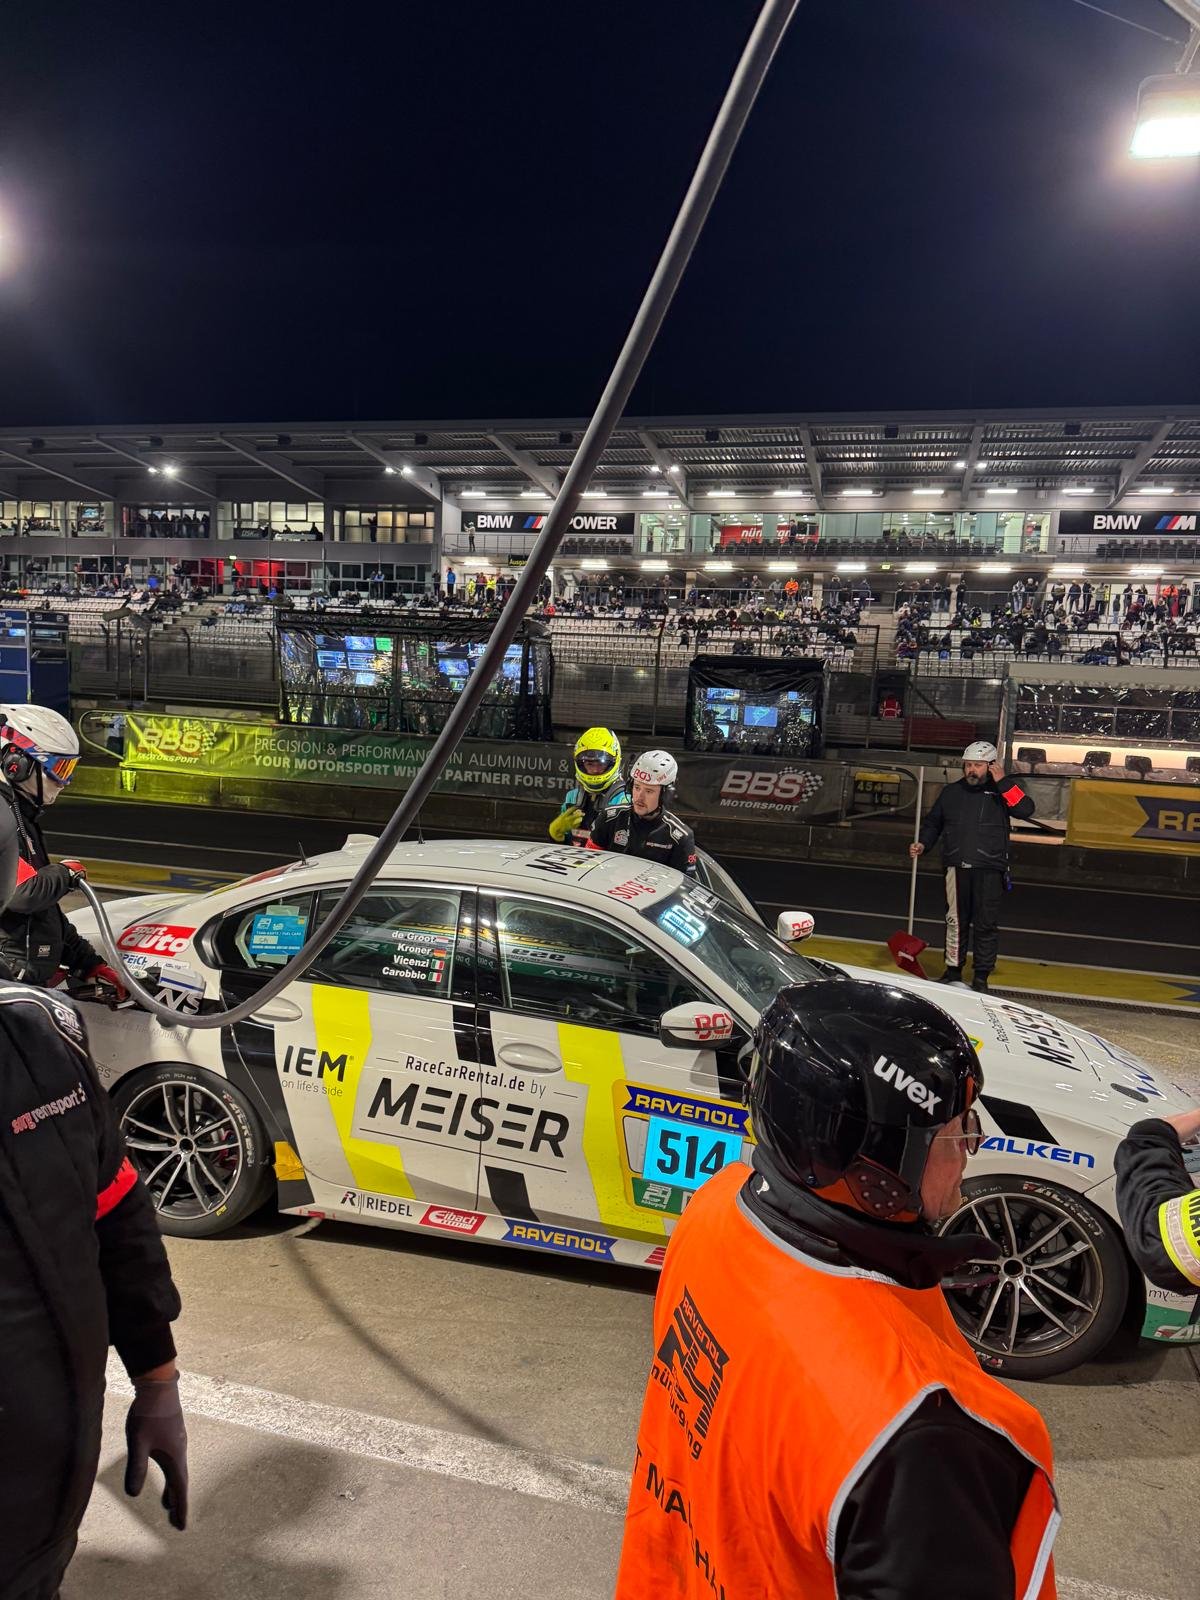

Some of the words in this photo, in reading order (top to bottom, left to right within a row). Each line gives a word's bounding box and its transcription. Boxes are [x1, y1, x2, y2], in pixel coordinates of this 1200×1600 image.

[477, 515, 514, 529] BMW
[1093, 515, 1141, 530] BMW
[137, 727, 202, 757] BBS
[255, 736, 322, 754] PRECISION
[326, 743, 337, 756] &
[342, 743, 432, 762] PERFORMAN
[468, 753, 552, 772] ALUMINUM
[558, 759, 569, 772] &
[137, 752, 199, 764] MOTORSPORT
[253, 755, 291, 769] YOUR
[294, 761, 390, 777] MOTORSPORT
[445, 769, 511, 785] PARTNER
[514, 774, 543, 788] FOR
[720, 770, 804, 802] BBS
[719, 799, 799, 813] MOTORSPORT
[121, 934, 191, 953] auto
[132, 926, 168, 936] sport
[391, 930, 404, 939] de
[407, 932, 436, 943] Groot
[393, 954, 429, 967] Vicenzi
[397, 943, 431, 955] Kroner
[382, 966, 427, 980] Carobbio
[283, 1045, 348, 1083] IEM
[282, 1079, 294, 1089] on
[297, 1079, 319, 1094] life's
[322, 1085, 343, 1097] side
[405, 1055, 525, 1092] RaceCarRental.de
[530, 1079, 547, 1099] by
[873, 1055, 943, 1116] uvex
[367, 1077, 570, 1159] MEISER
[634, 1093, 740, 1129] RAVENOL
[657, 1129, 727, 1180] 514
[980, 1135, 1095, 1169] ALKEN
[366, 1196, 413, 1217] RIEDEL
[428, 1209, 478, 1227] Eibach
[513, 1225, 606, 1254] RAVENOL
[682, 1297, 721, 1369] RAVENOL
